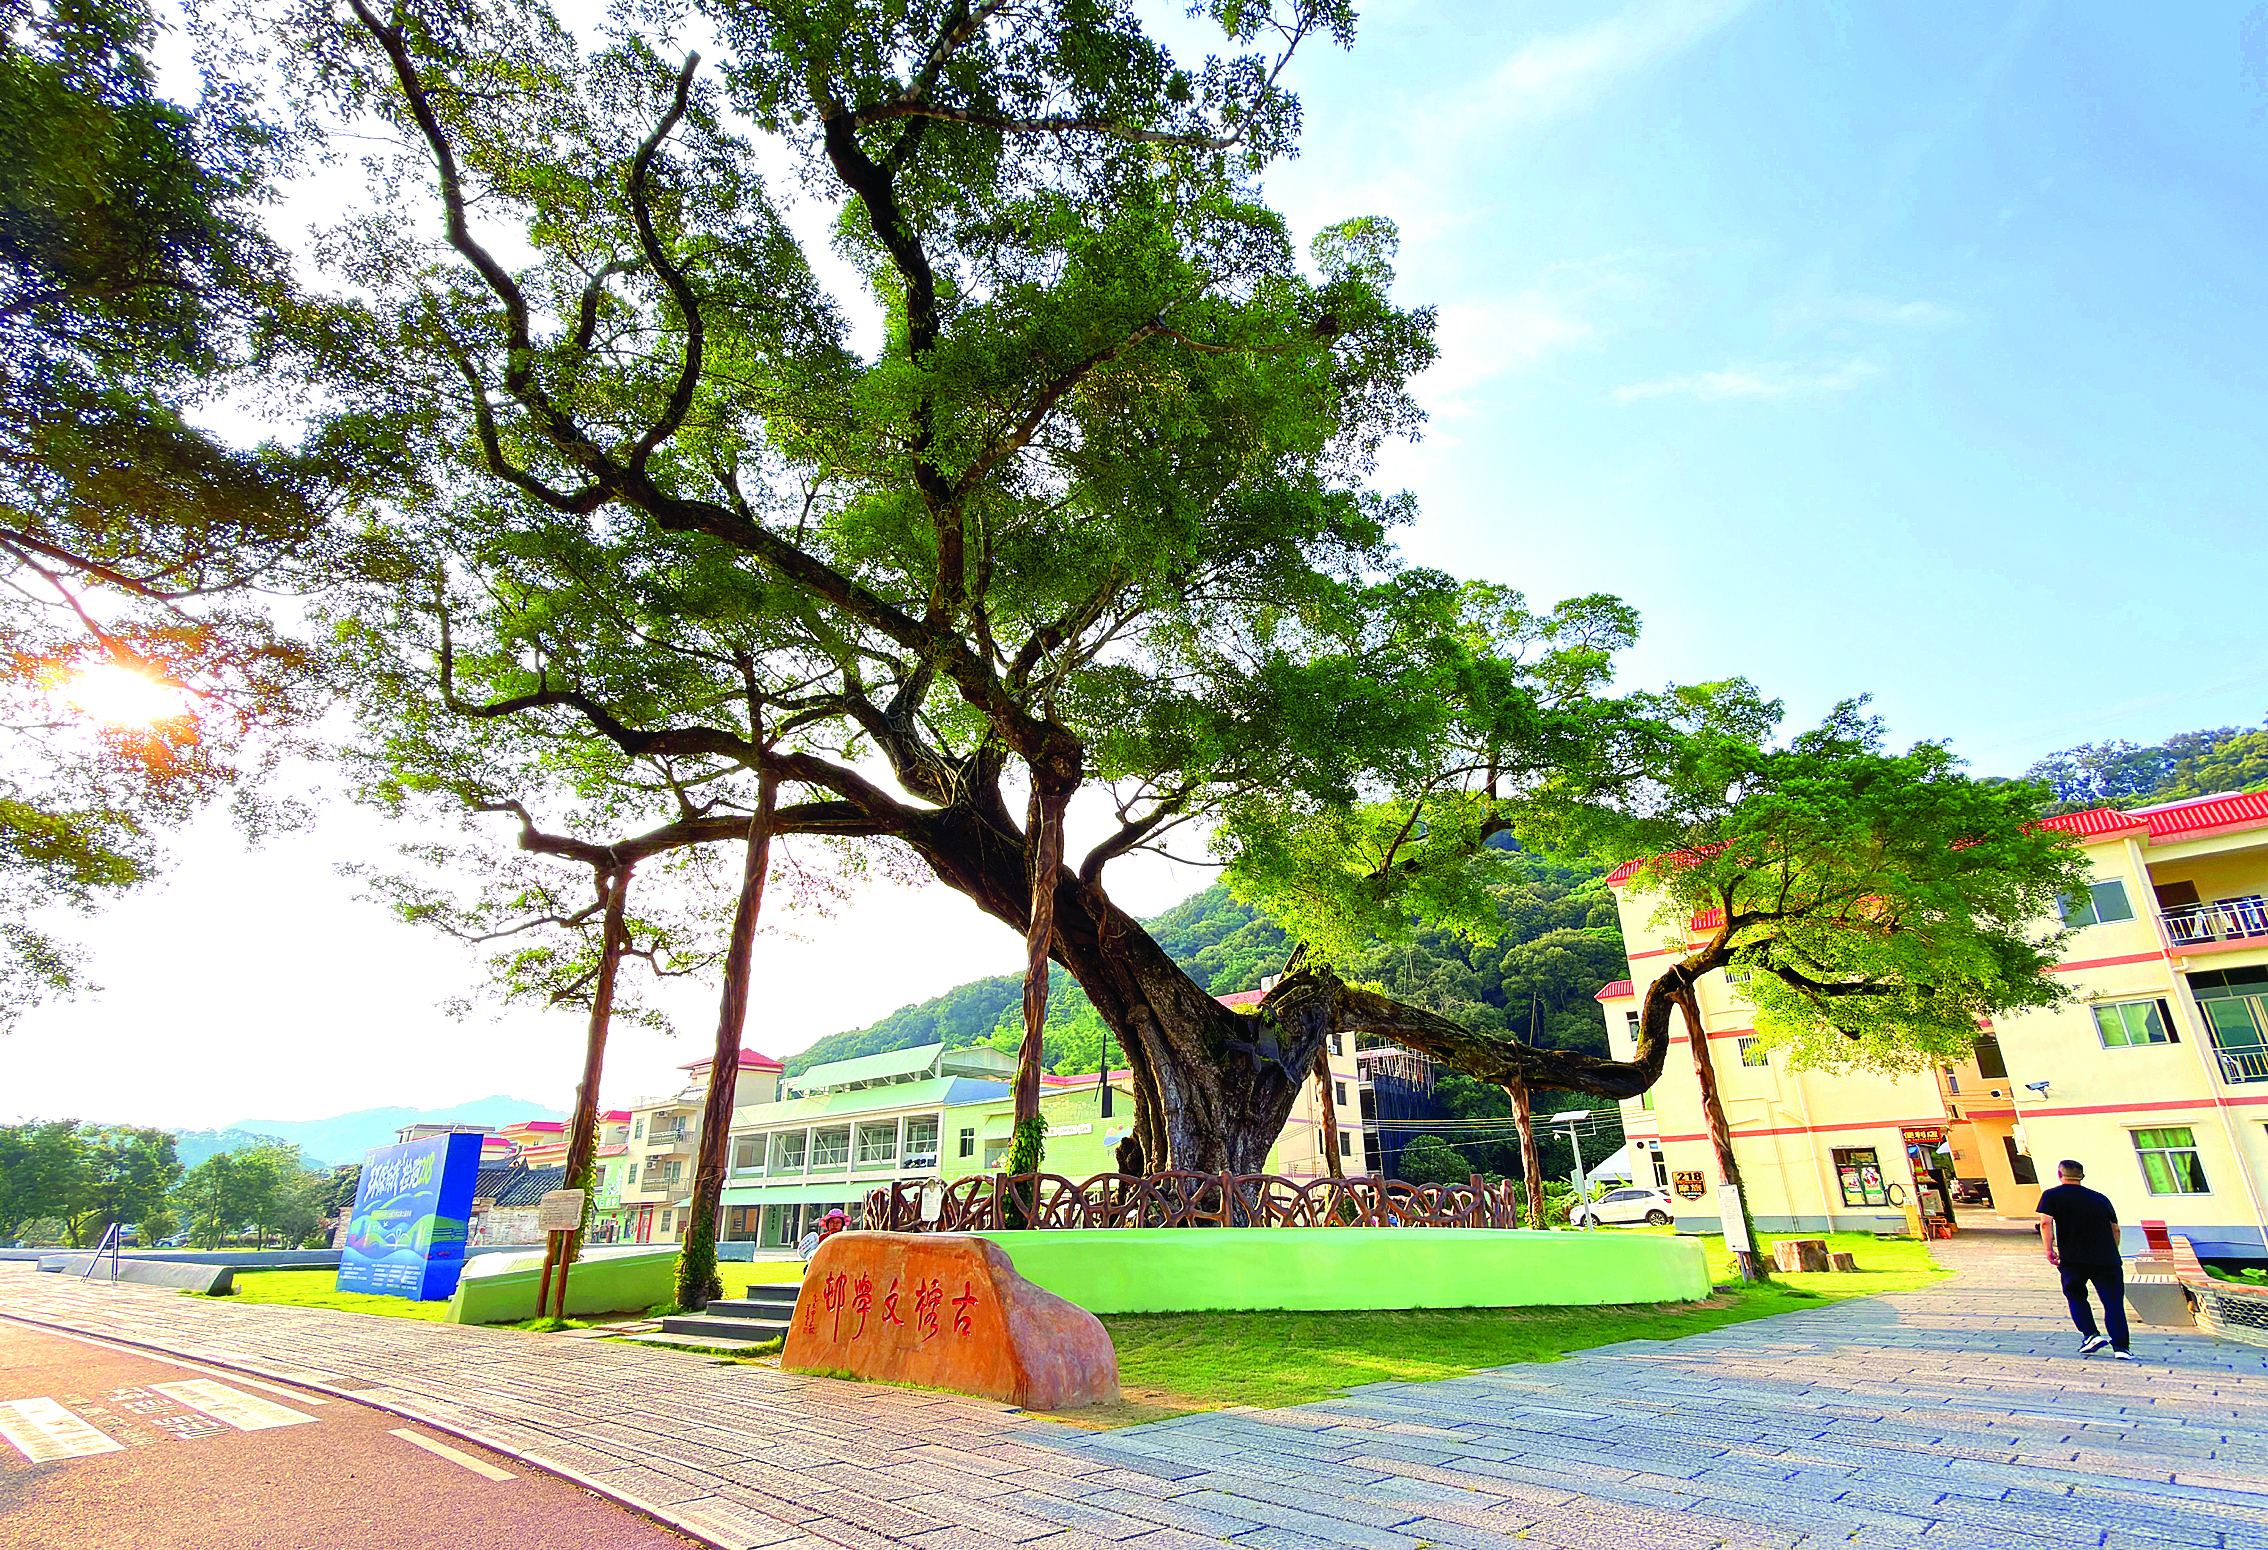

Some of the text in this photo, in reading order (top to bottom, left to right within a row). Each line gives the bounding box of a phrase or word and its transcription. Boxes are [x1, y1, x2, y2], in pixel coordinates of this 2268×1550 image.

[1903, 1130, 1939, 1139] 便利店
[1677, 1172, 1703, 1181] 218
